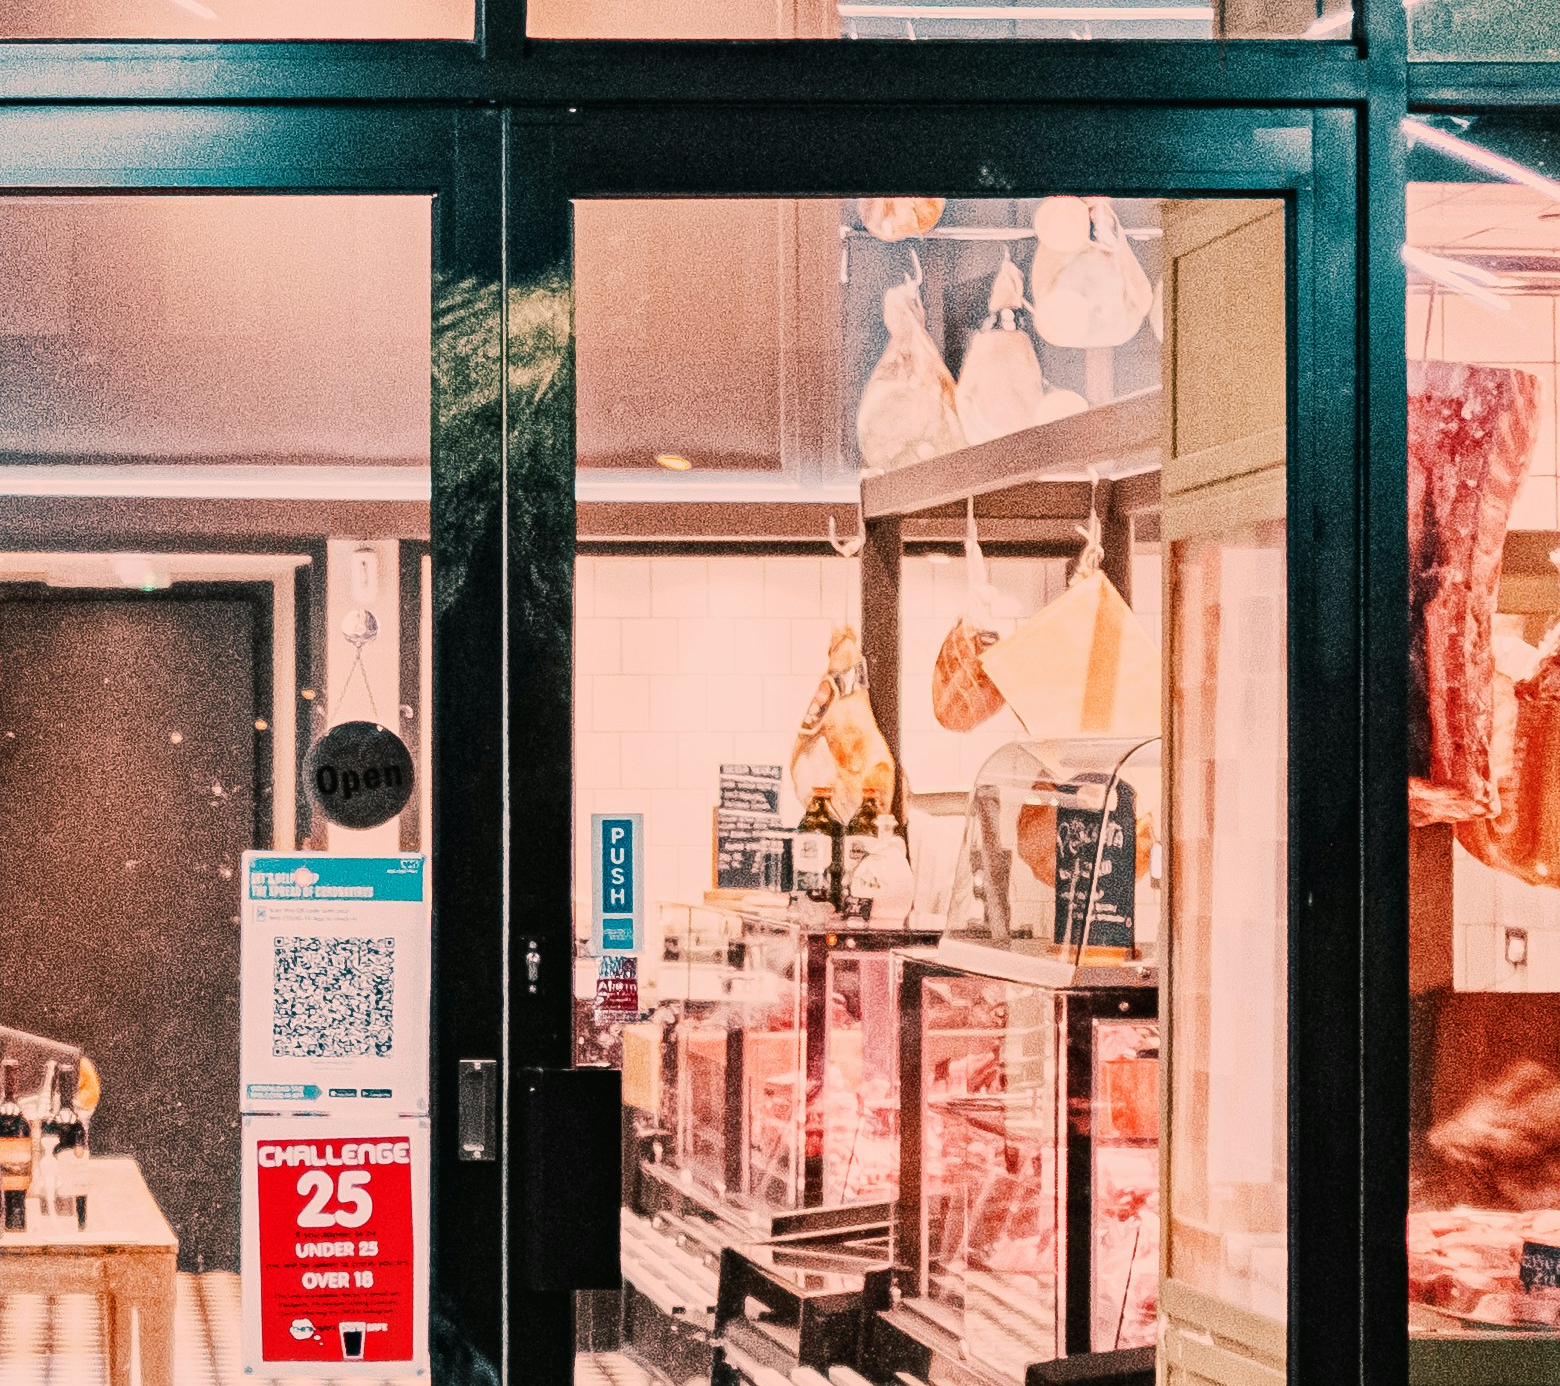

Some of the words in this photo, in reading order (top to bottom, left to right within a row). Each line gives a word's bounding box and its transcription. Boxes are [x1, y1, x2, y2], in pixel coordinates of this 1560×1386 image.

[317, 765, 402, 800] Open
[610, 827, 625, 905] PUSH
[258, 1141, 411, 1168] CHALLENGE
[296, 1169, 373, 1229] 25
[295, 1241, 355, 1259] UNDER
[358, 1240, 379, 1257] 25
[301, 1271, 350, 1290] OVER
[353, 1269, 374, 1289] 18
